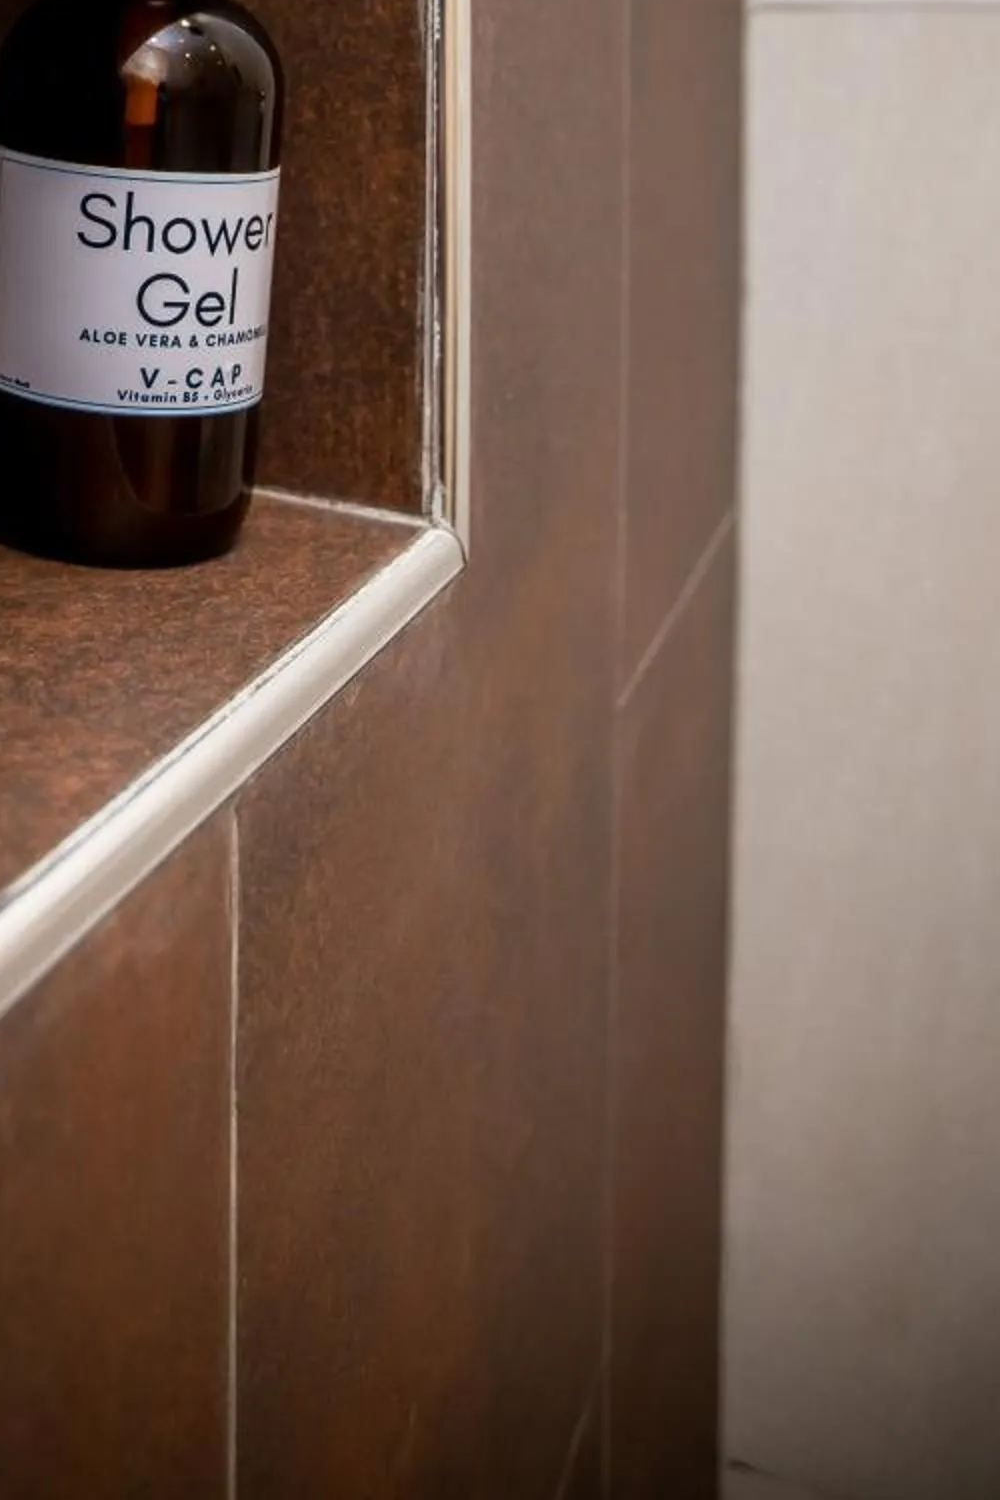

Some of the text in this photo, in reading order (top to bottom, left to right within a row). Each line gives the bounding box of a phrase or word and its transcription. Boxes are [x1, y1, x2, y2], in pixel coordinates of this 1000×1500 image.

[77, 191, 274, 255] Shower
[136, 267, 239, 327] Gel
[79, 328, 127, 345] ALOE
[136, 332, 181, 348] VERA
[189, 334, 198, 347] &
[118, 389, 177, 403] Vitamin
[183, 391, 198, 403] B5
